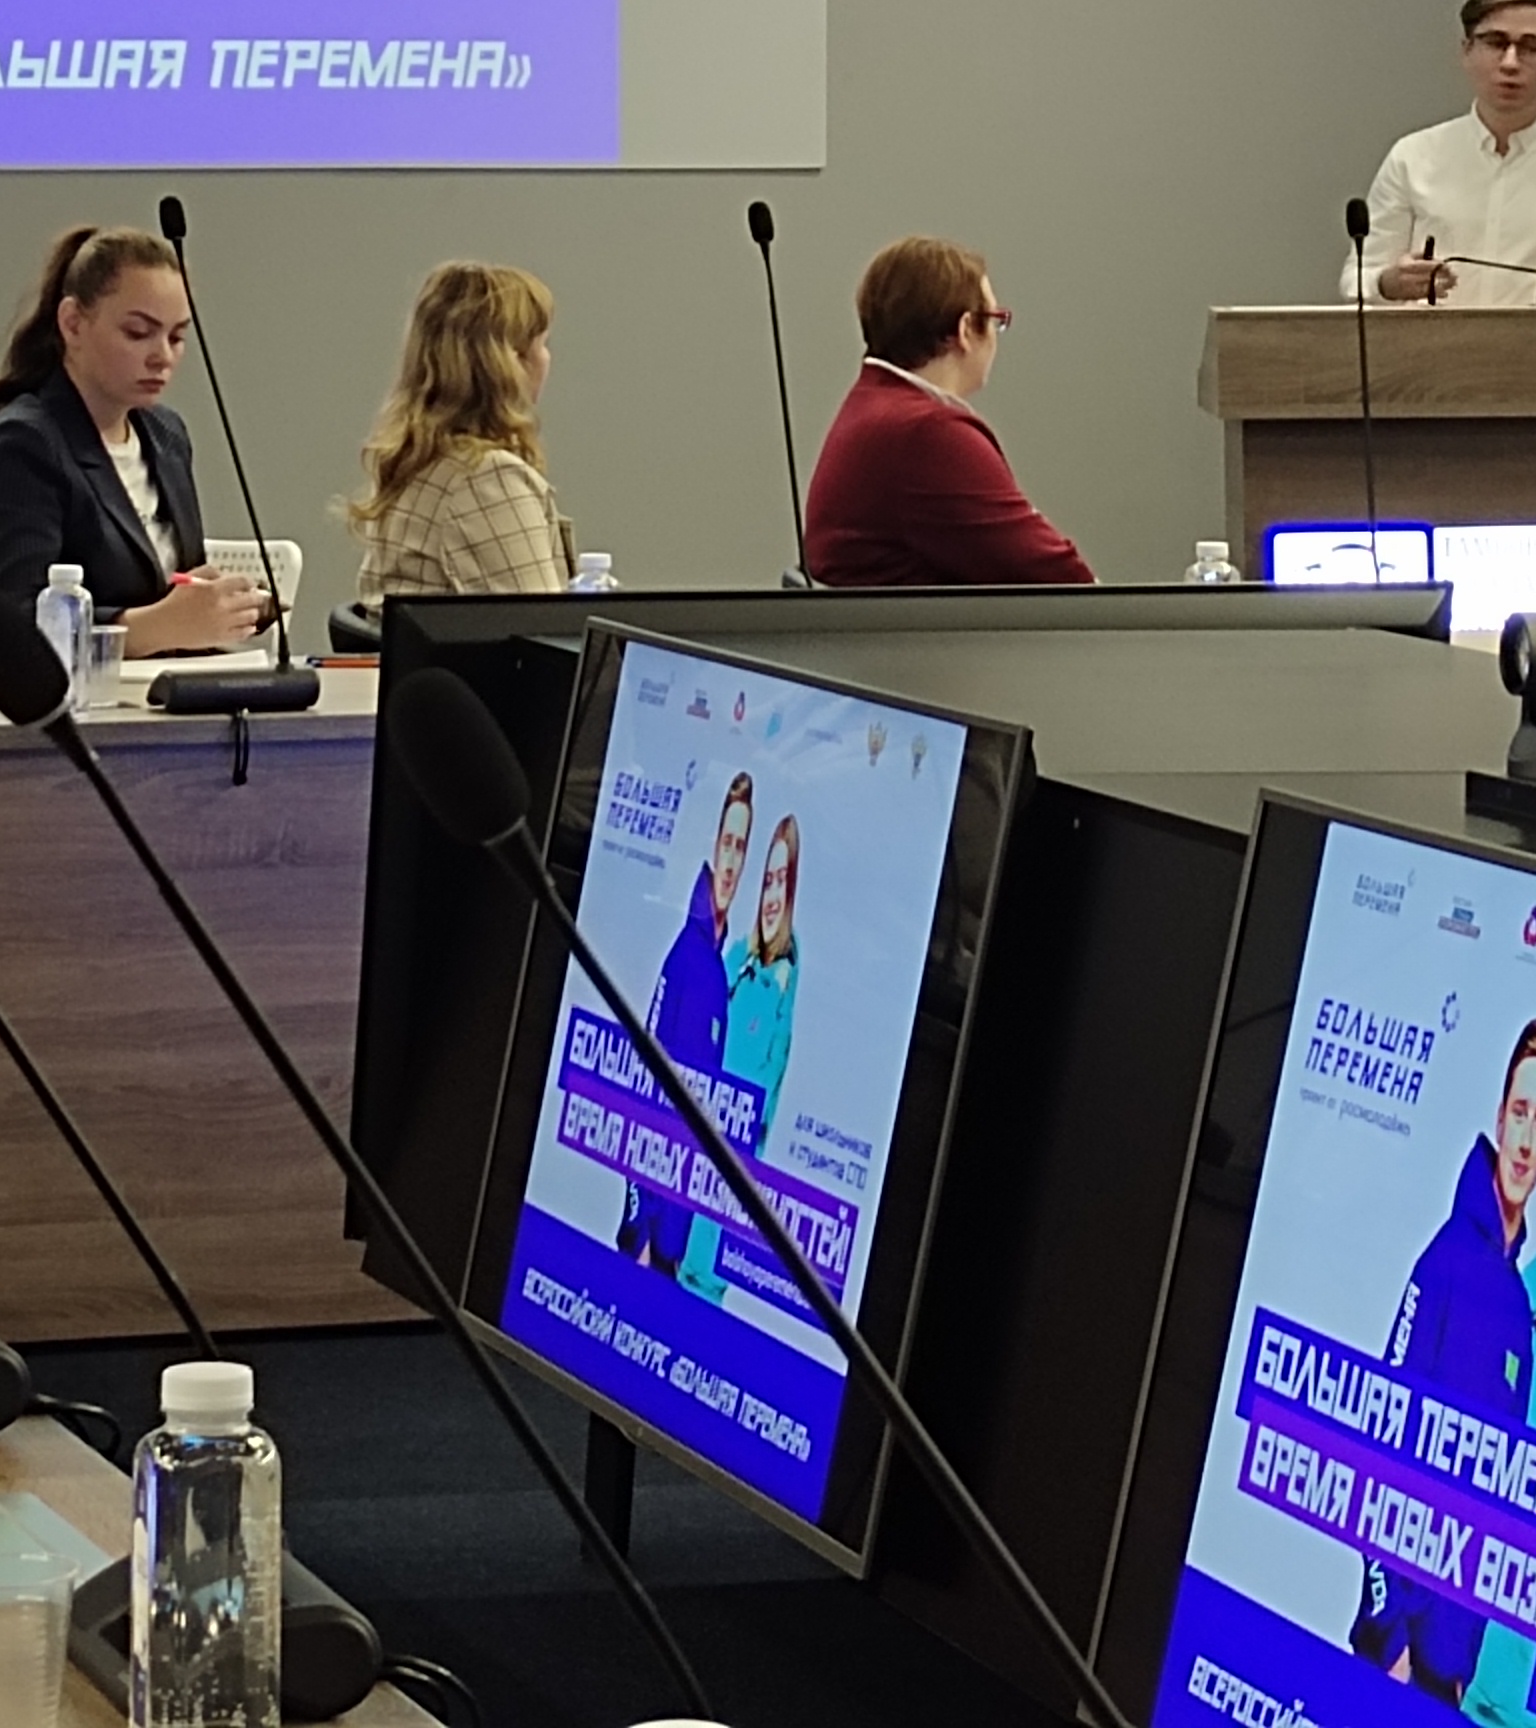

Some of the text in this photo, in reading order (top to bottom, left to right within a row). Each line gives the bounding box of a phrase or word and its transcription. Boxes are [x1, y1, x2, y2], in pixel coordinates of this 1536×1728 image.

[210, 39, 531, 91] ПЕРЕМЕНА»
[613, 772, 682, 814] БОЛЬШАЯ
[1316, 998, 1435, 1064] БОЛЬШАЯ
[1304, 1036, 1424, 1106] ПЕРЕМЕНА
[564, 1092, 624, 1161] ВРЕМЯ
[624, 1121, 689, 1193] НОВЫХ
[1254, 1325, 1412, 1450] БОЛЬШАЯ
[1249, 1424, 1356, 1529] ВРЕМЯ
[1356, 1477, 1474, 1589] НОВЫХ
